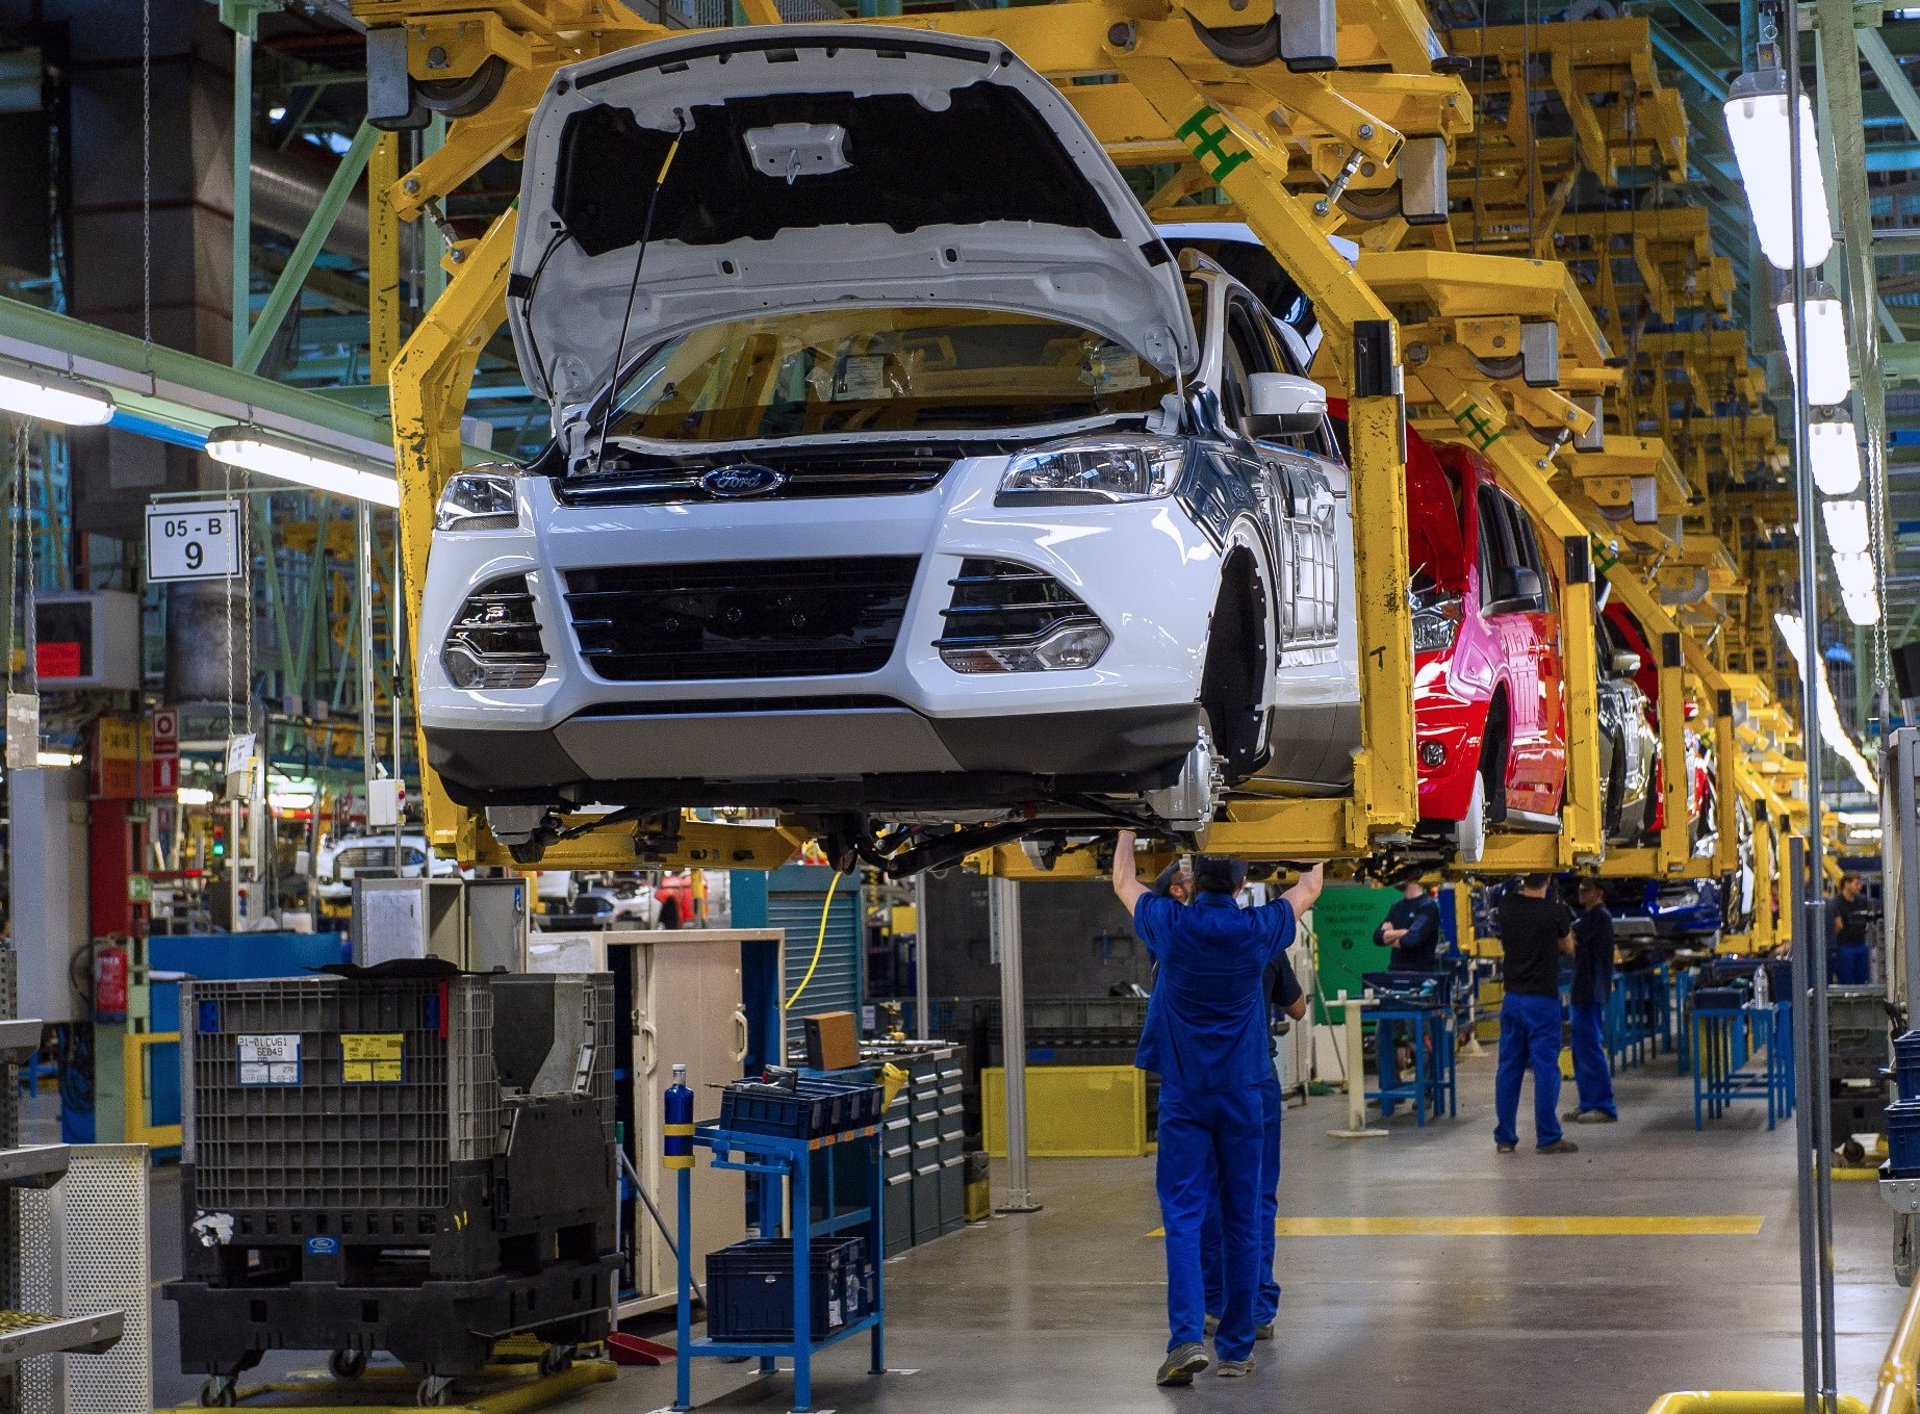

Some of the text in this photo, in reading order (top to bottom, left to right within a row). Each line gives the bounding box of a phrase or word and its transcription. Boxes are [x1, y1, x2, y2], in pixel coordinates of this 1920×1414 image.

[716, 469, 763, 489] Ford
[164, 520, 188, 537] 05
[208, 518, 222, 535] B
[184, 541, 204, 570] 9
